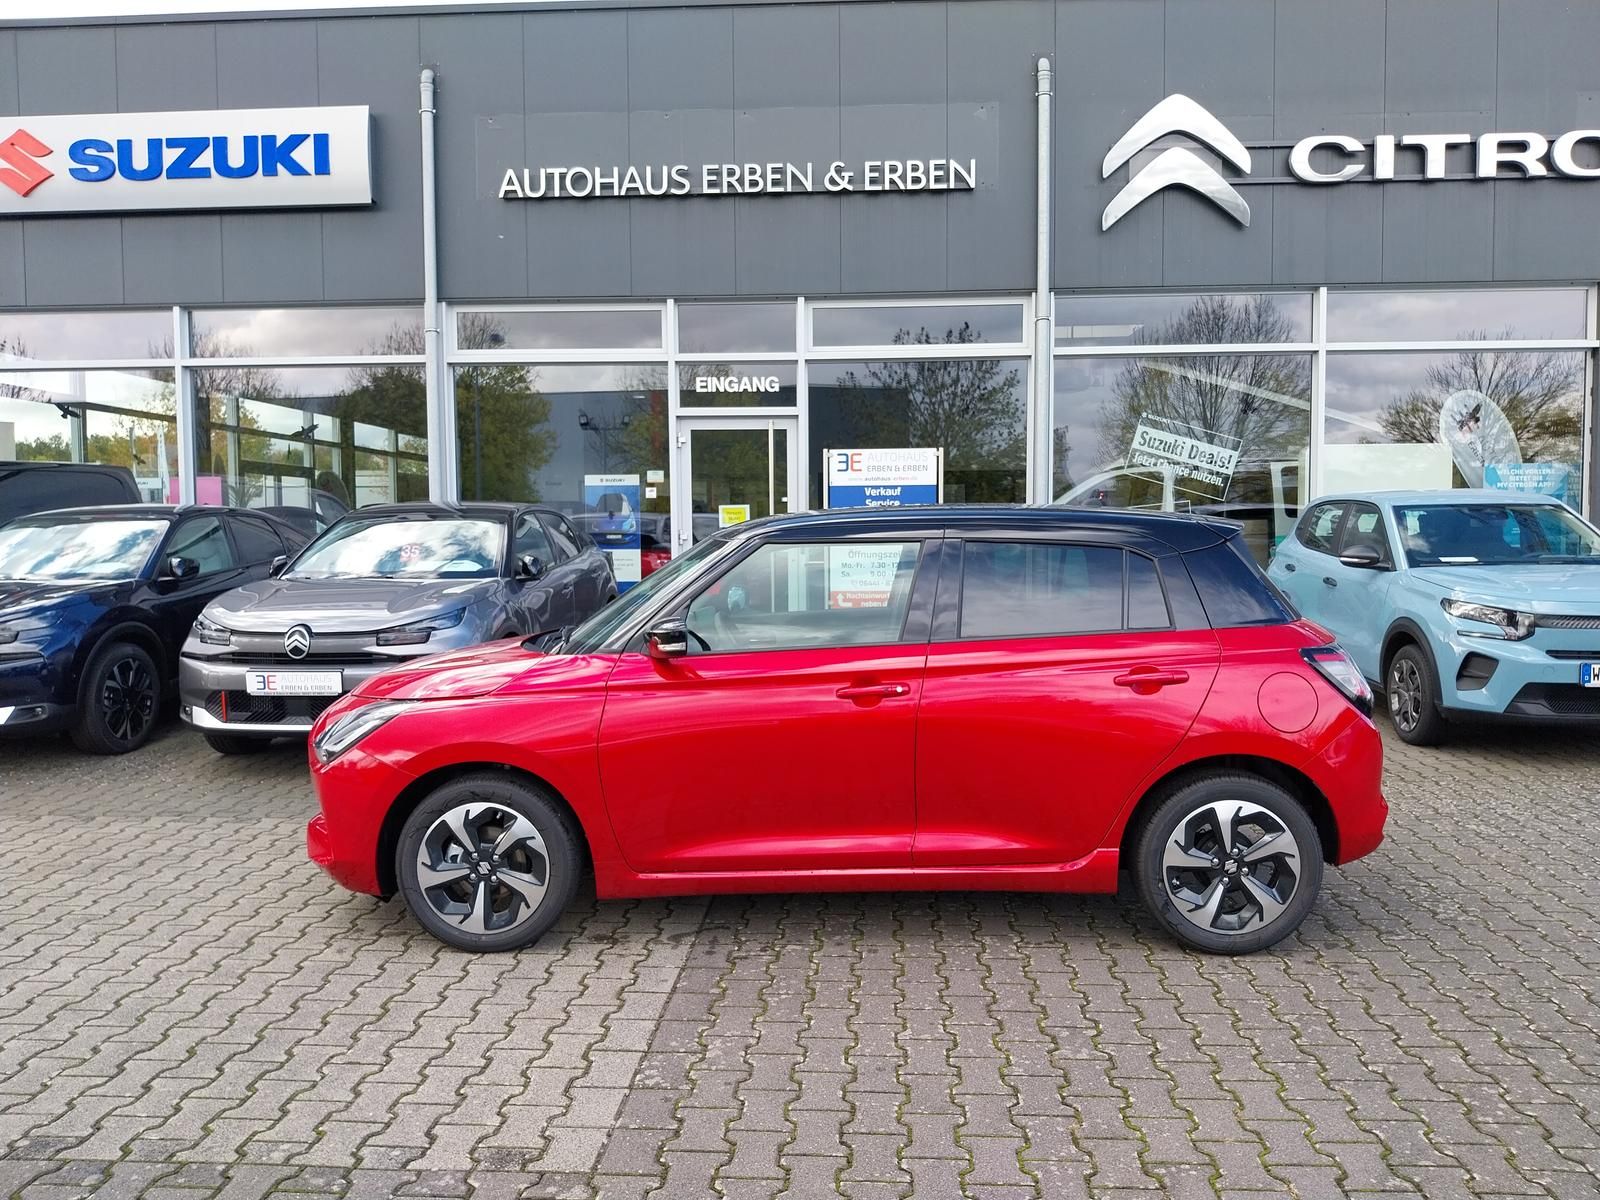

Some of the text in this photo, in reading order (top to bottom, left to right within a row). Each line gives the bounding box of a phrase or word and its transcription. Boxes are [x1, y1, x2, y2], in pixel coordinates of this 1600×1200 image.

[68, 133, 331, 182] SUZUKI
[498, 158, 977, 199] AUTOHAUS ERBEN & ERBEN
[695, 376, 780, 393] EINGANG
[1138, 430, 1233, 470] Suzuki Deals!
[867, 451, 929, 463] AUTOHAUS
[867, 465, 893, 473] ERBEN
[902, 464, 928, 472] ERBEN
[1132, 451, 1224, 487] Jetzt Chance nutzen.
[864, 486, 902, 497] Verkauf
[865, 499, 900, 507] Service
[401, 544, 420, 557] 35
[281, 675, 332, 684] AUTOHAUS
